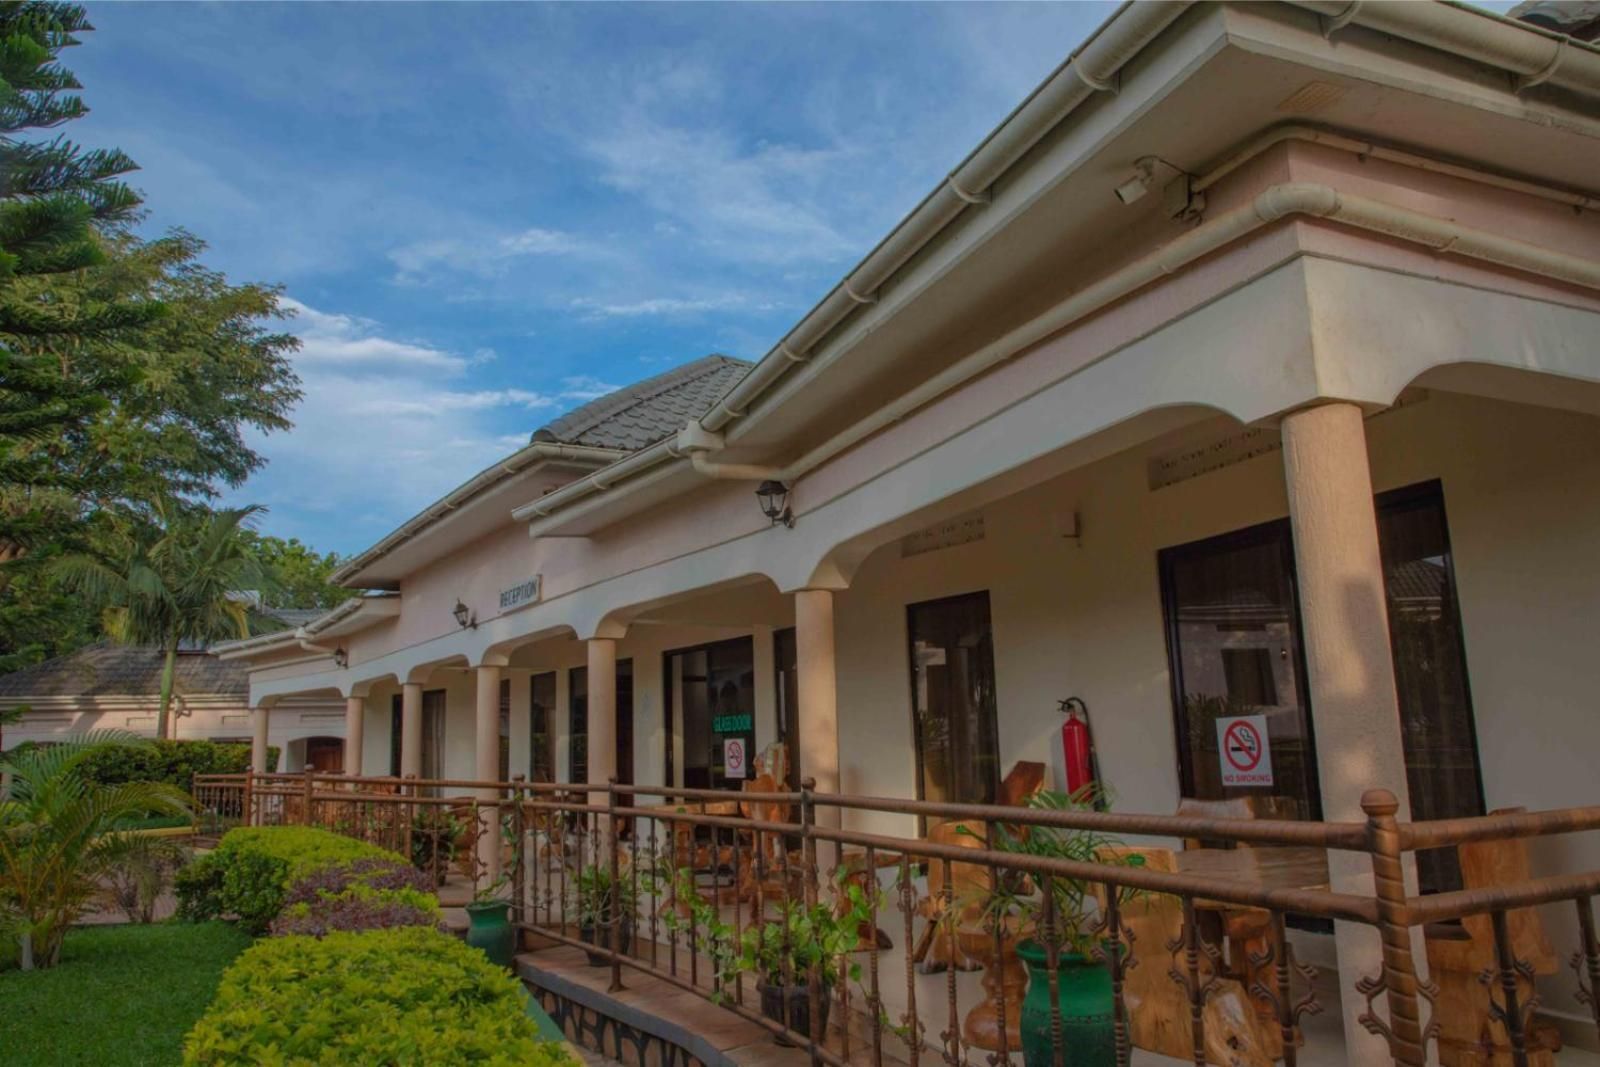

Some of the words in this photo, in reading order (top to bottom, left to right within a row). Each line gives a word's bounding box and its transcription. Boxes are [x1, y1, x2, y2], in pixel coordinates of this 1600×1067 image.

[500, 580, 537, 608] RECEPTION
[1223, 774, 1233, 783] NO
[1236, 774, 1272, 783] SMOKING
